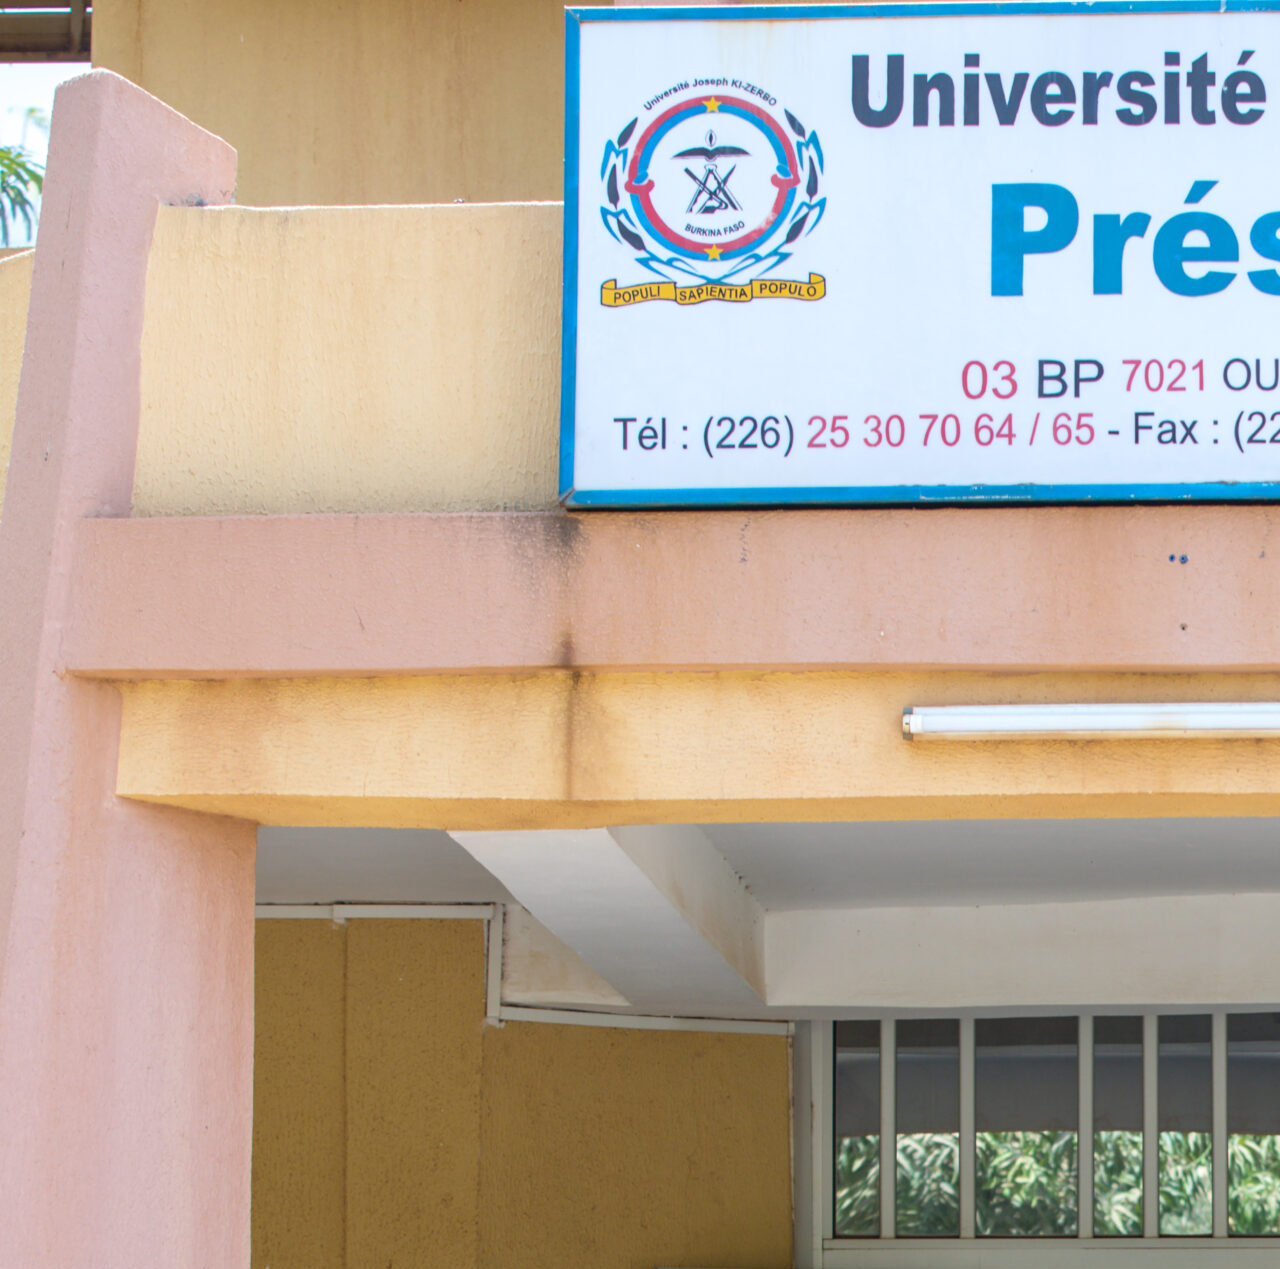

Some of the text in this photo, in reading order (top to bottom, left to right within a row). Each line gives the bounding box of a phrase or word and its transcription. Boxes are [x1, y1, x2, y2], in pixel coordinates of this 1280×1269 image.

[643, 77, 777, 111] Université Joseph KI-ZERBO
[851, 49, 1268, 129] Université
[684, 220, 745, 237] BURKINA FASO
[613, 282, 817, 304] POPULI SAPIENTIA POPULO
[962, 360, 1018, 400] 03
[1037, 358, 1105, 399] BP
[1122, 359, 1205, 393] 7021
[613, 416, 667, 451] Tél
[703, 414, 795, 459] (226)
[807, 416, 850, 449] 25
[864, 414, 906, 448] 30
[919, 414, 961, 448] 70
[974, 413, 1017, 447] 64
[1053, 413, 1095, 446] 65
[1134, 411, 1200, 445] Fax
